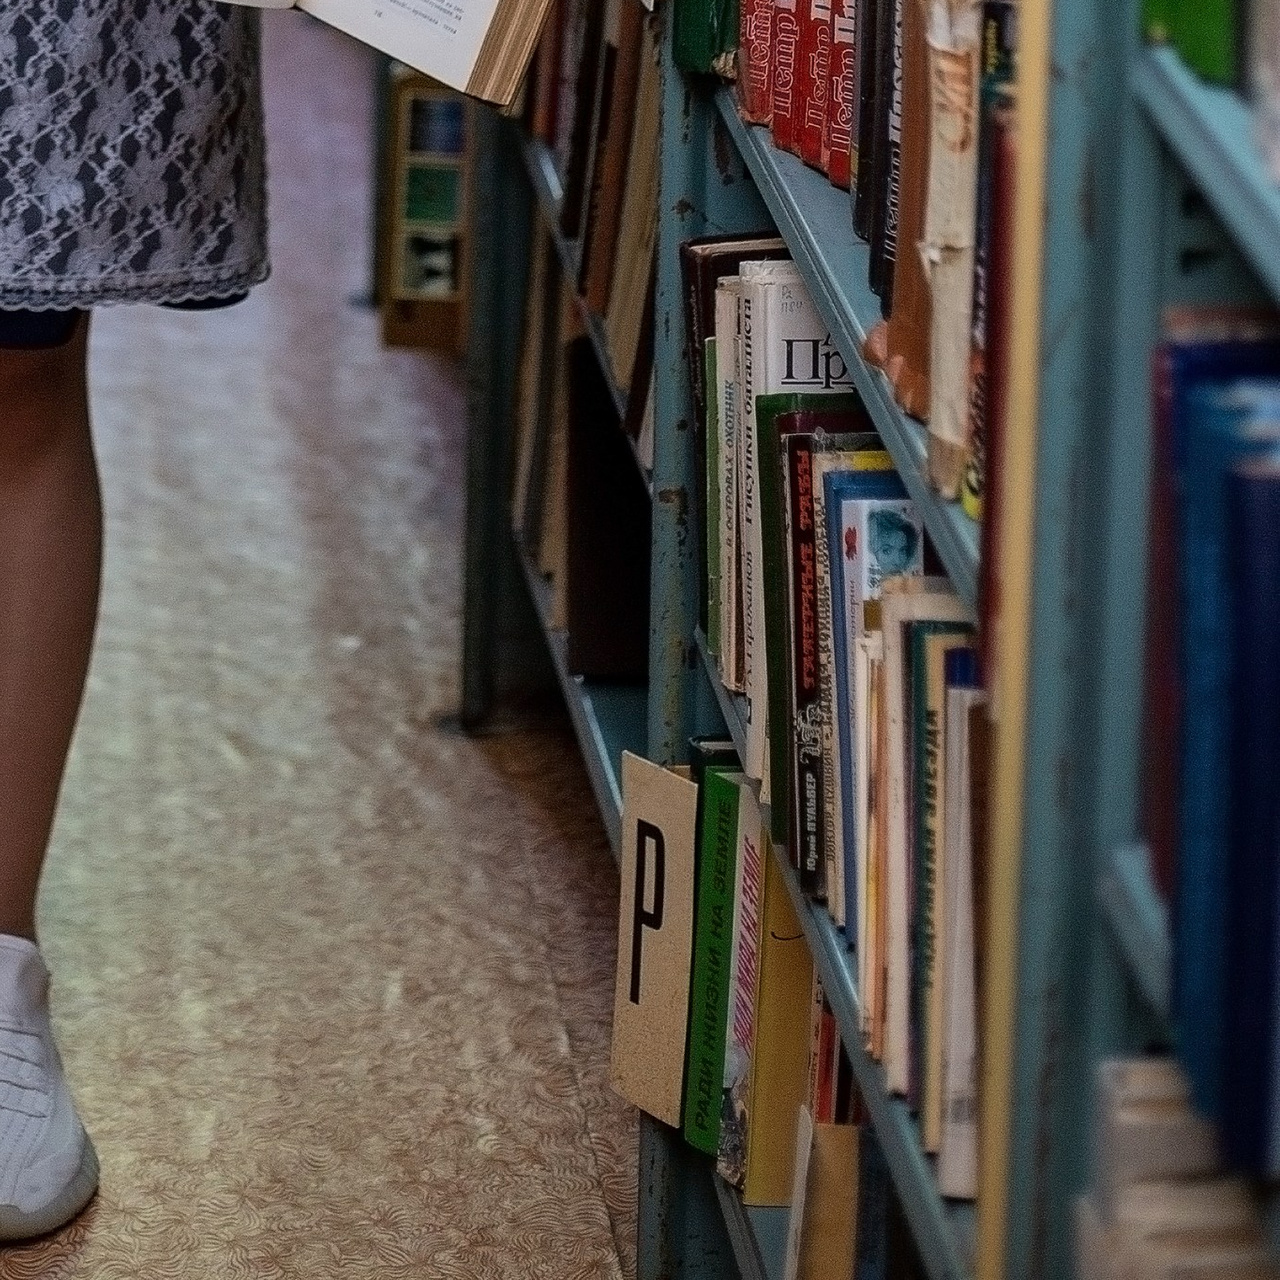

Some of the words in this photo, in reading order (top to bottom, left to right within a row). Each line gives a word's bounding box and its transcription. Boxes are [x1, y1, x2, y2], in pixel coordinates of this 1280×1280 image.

[774, 13, 799, 118] Петр
[743, 297, 753, 416] баталиста
[723, 378, 735, 449] ОХОТНИК
[723, 453, 735, 539] ОСТРОВАХ
[806, 772, 816, 824] ПУЛЬВЕР
[706, 797, 737, 894] ЗЕМЛЕ
[630, 817, 665, 1005] Р
[707, 902, 727, 939] НА
[695, 947, 728, 1051] ЖИЗНИ
[691, 1057, 717, 1131] РАДИ
